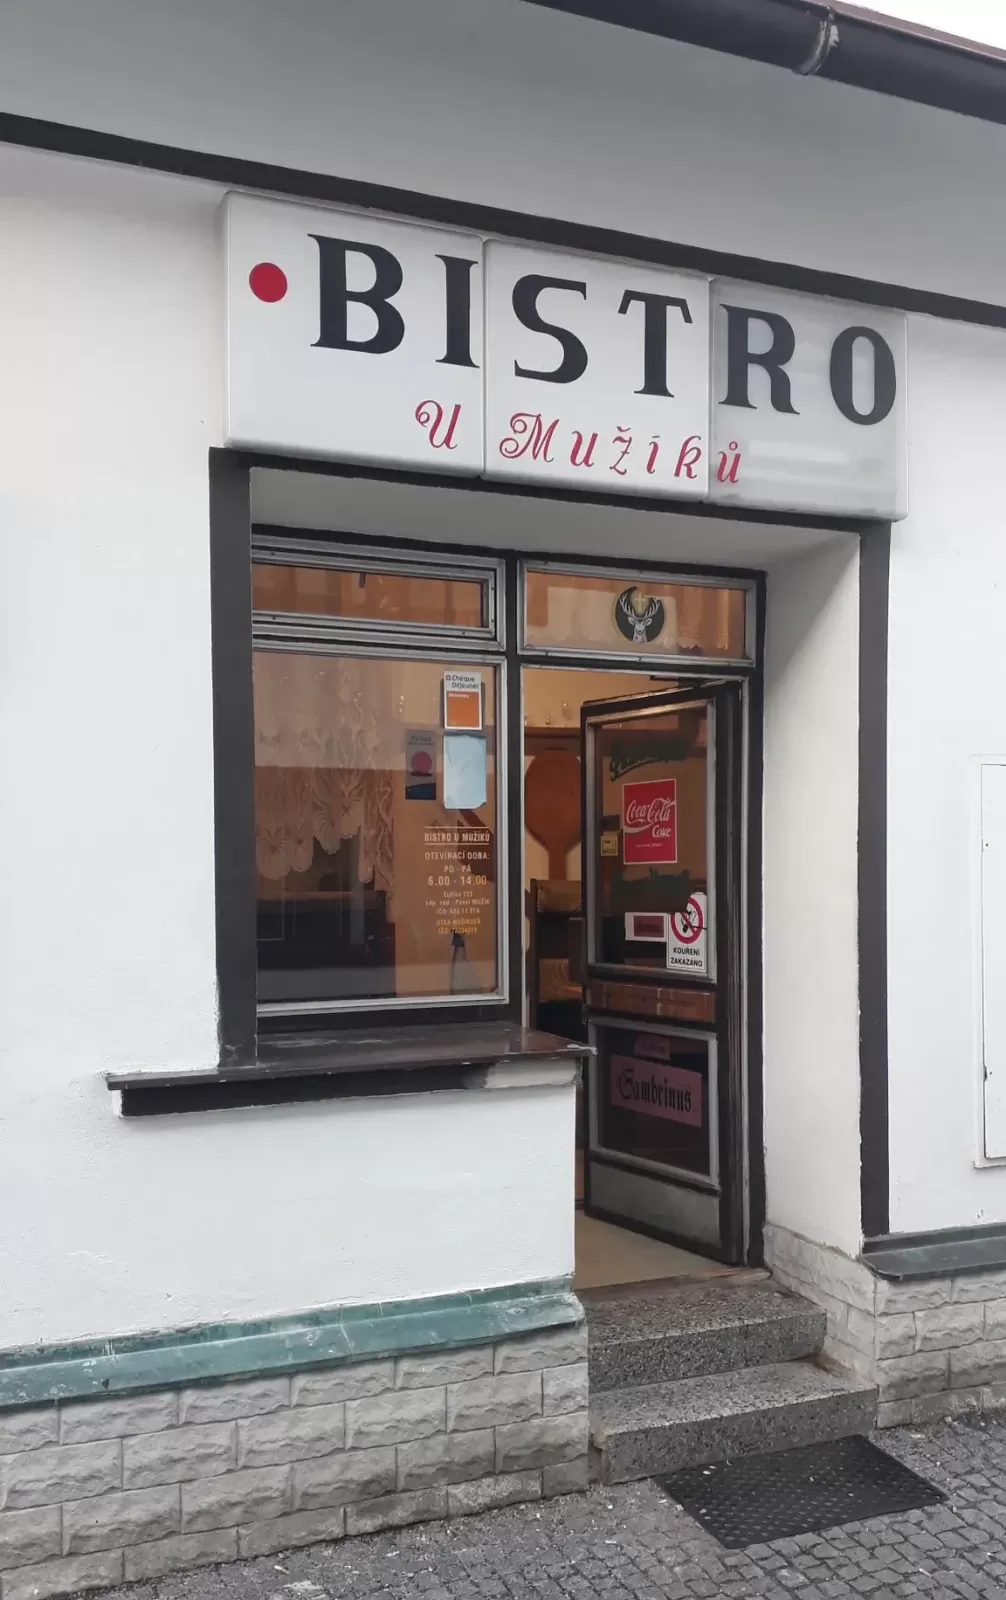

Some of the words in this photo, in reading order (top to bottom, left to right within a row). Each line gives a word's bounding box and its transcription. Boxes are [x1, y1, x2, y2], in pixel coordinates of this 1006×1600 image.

[307, 232, 897, 426] BISTRO
[415, 399, 462, 450] U
[499, 412, 740, 484] Mužíků
[652, 824, 672, 839] Coke
[427, 875, 450, 886] 6.00
[460, 874, 487, 886] 14.00
